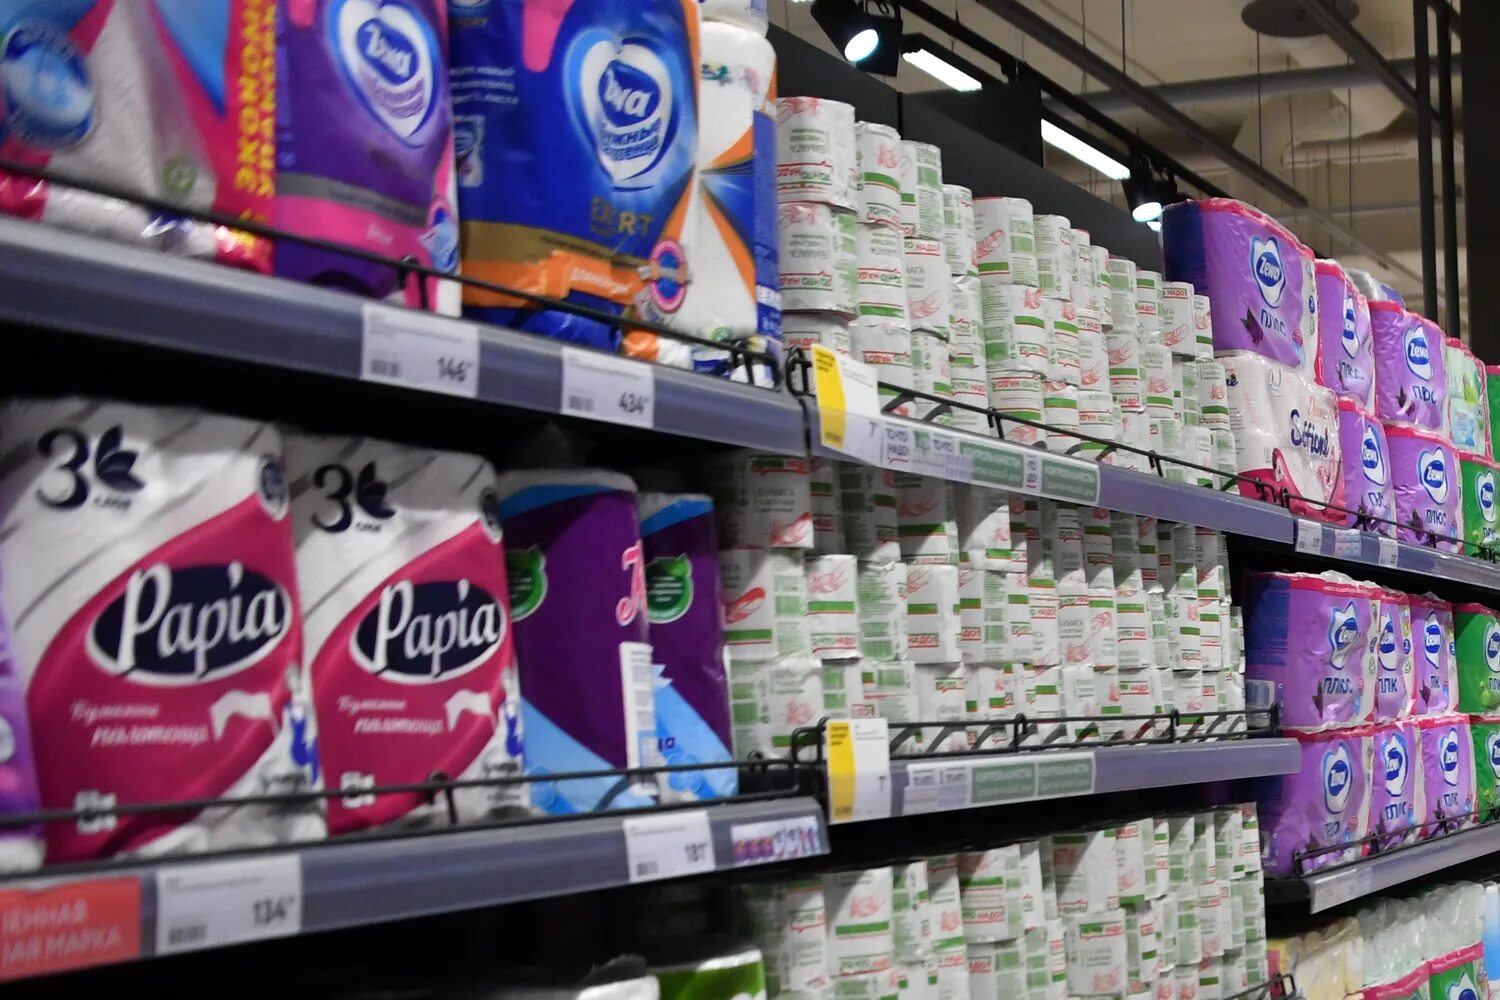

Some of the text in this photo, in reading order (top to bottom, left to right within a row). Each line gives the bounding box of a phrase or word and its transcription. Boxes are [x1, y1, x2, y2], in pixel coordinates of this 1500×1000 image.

[1258, 259, 1282, 283] Zewa
[36, 426, 90, 510] 3
[311, 463, 353, 533] 3
[116, 560, 282, 678] Papia
[373, 578, 498, 679] Papia
